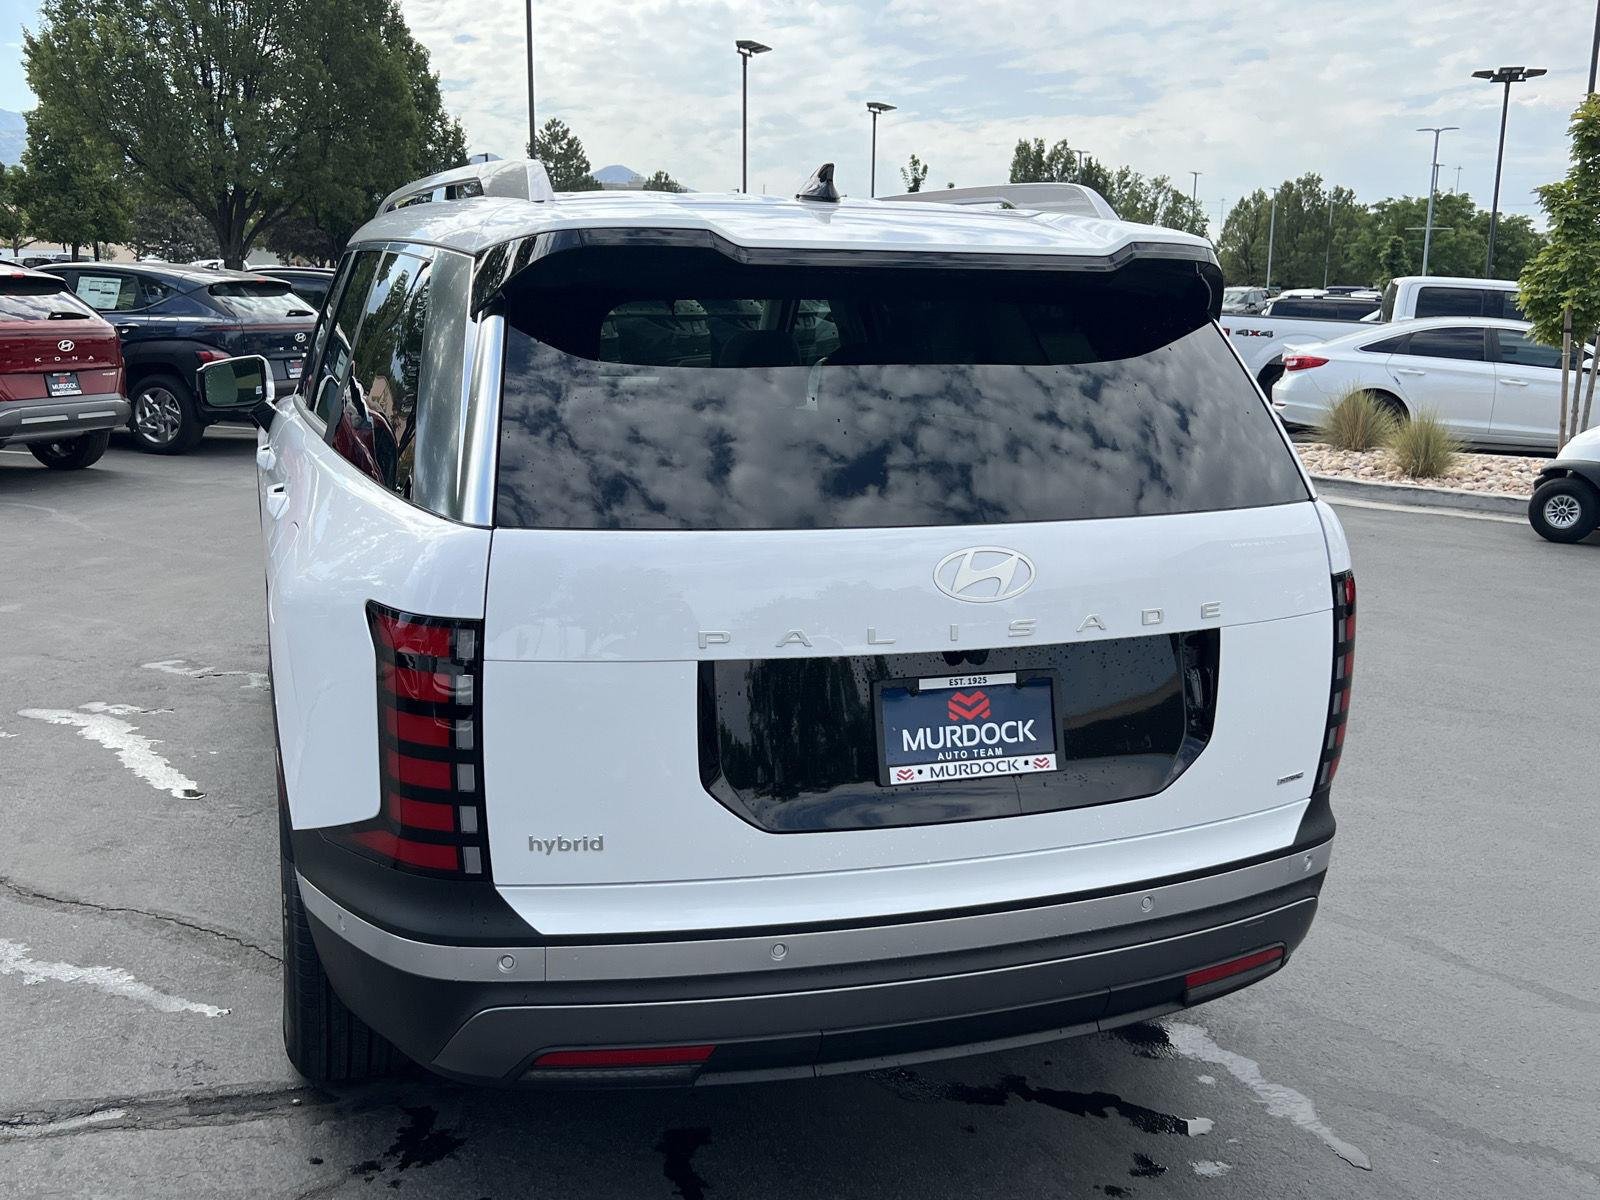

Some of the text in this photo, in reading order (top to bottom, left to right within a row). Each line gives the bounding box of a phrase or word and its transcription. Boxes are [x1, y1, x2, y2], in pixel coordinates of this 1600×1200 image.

[34, 355, 94, 363] KONA
[697, 601, 1224, 649] PALISADE
[968, 677, 987, 685] 1925
[902, 719, 1037, 751] MURDOCK
[937, 747, 1003, 761] AUTO TEAM
[930, 759, 1020, 778] MURDOCK
[528, 833, 604, 855] hybrid
